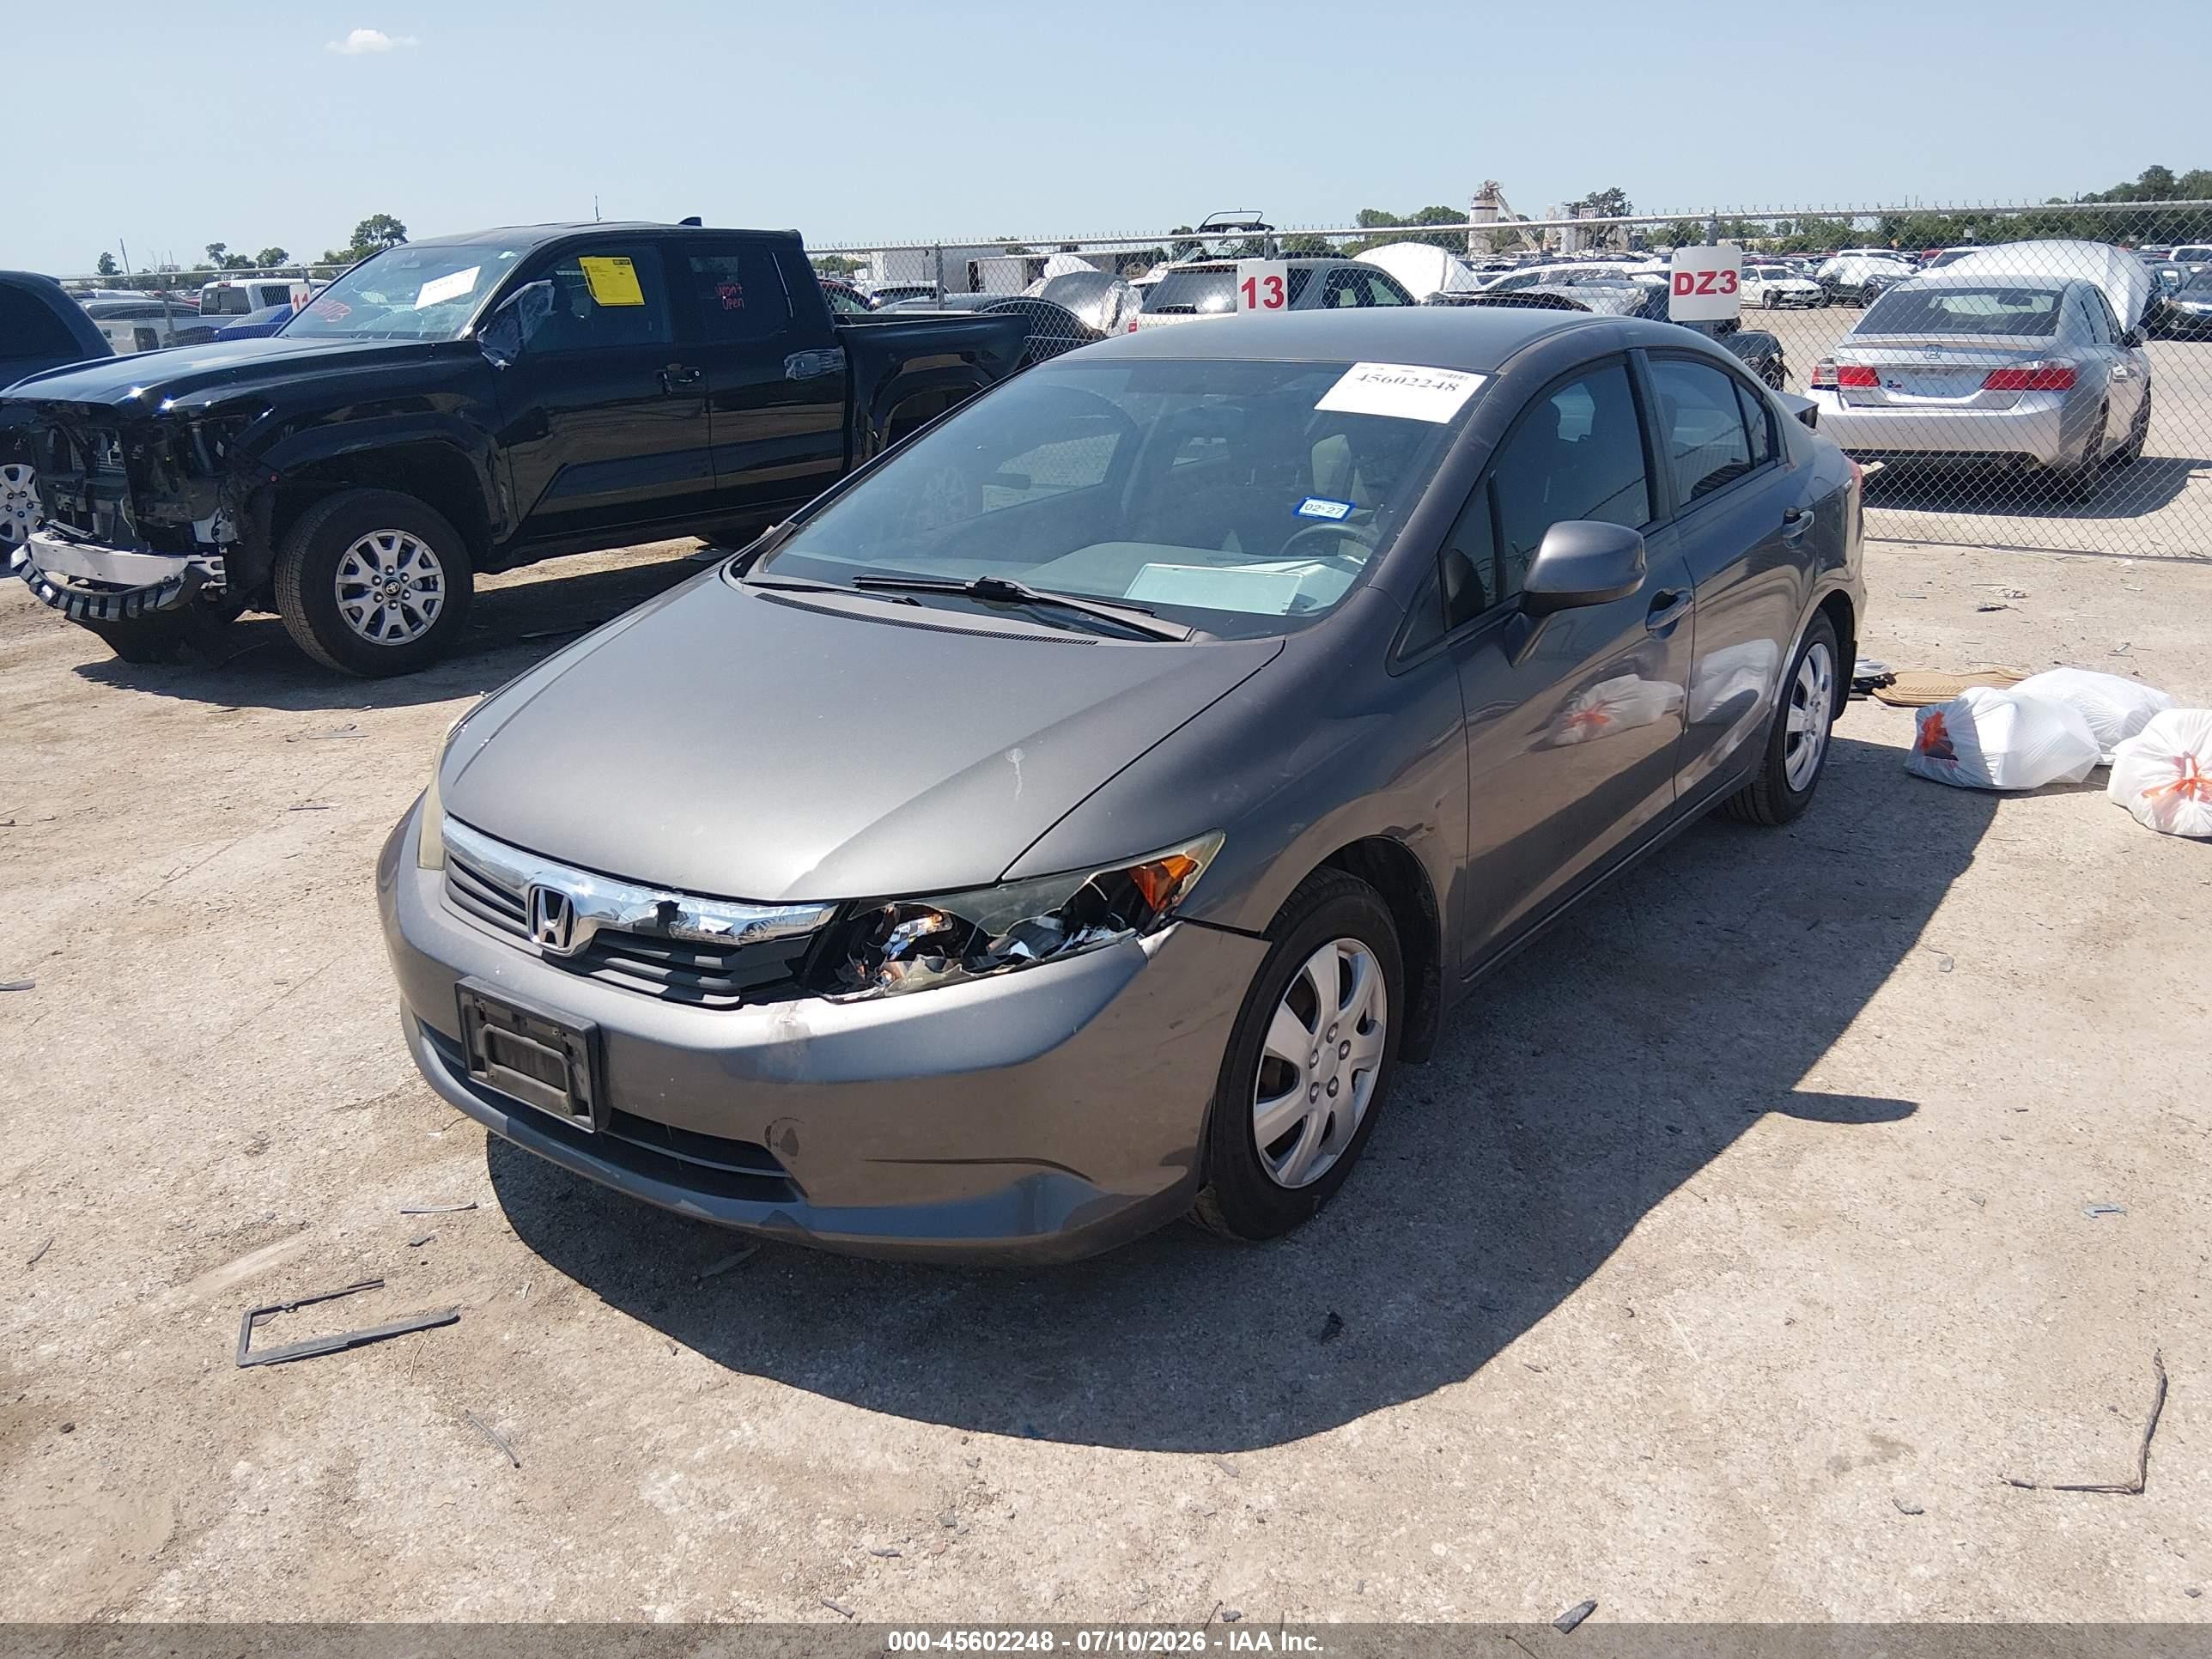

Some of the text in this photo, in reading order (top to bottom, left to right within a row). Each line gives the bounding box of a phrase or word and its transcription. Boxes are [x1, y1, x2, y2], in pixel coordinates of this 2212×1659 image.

[1241, 276, 1285, 309] 13
[1674, 270, 1738, 296] DZ3
[1355, 373, 1461, 392] 45602248
